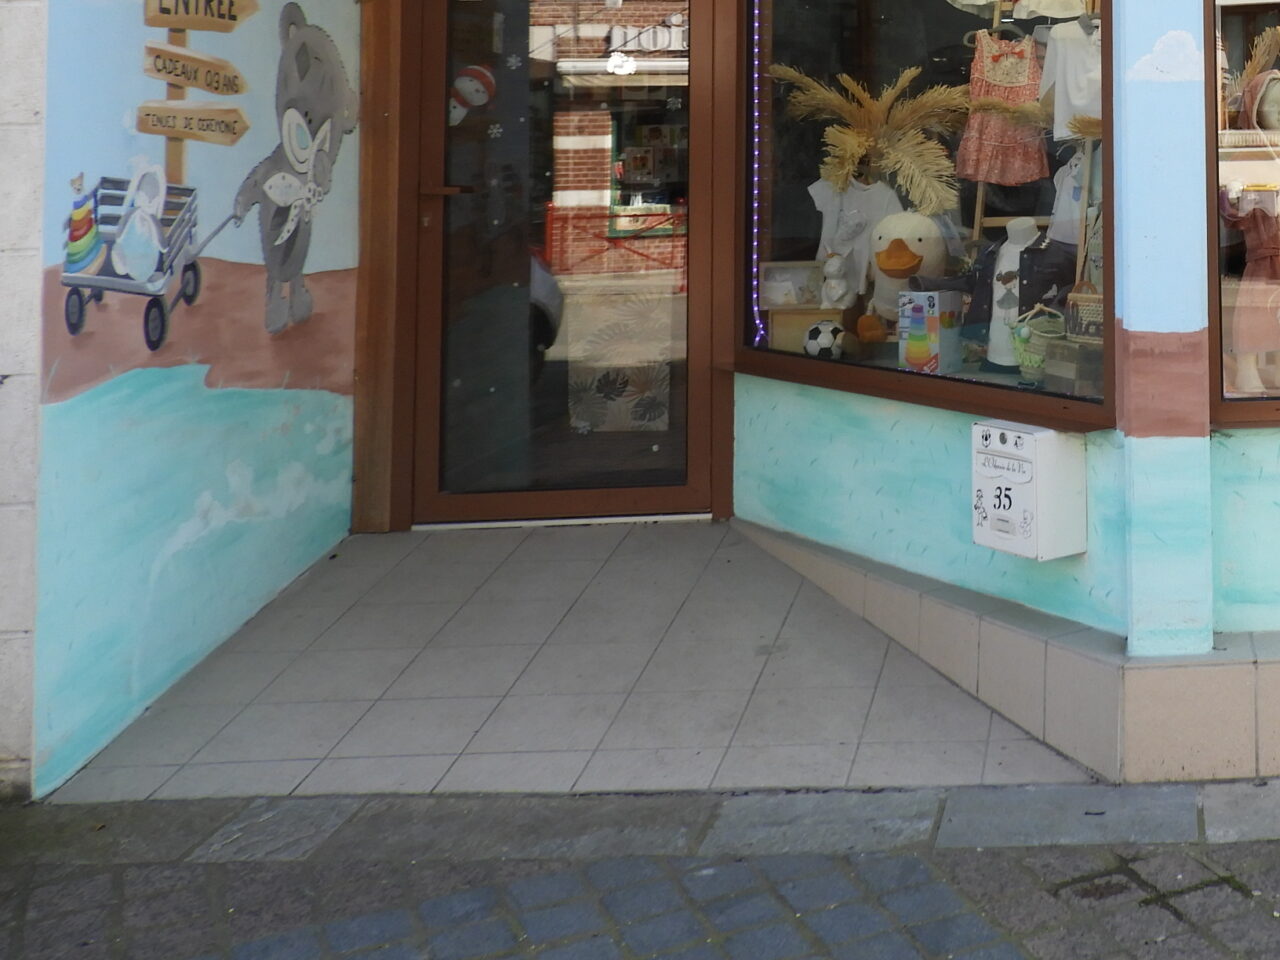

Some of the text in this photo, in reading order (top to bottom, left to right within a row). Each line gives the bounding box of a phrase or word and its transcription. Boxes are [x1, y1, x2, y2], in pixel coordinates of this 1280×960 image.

[154, 54, 199, 81] CADEAUX
[222, 74, 239, 93] ANS
[144, 113, 176, 128] TENUES
[184, 116, 193, 130] DE
[993, 486, 1013, 511] 35
